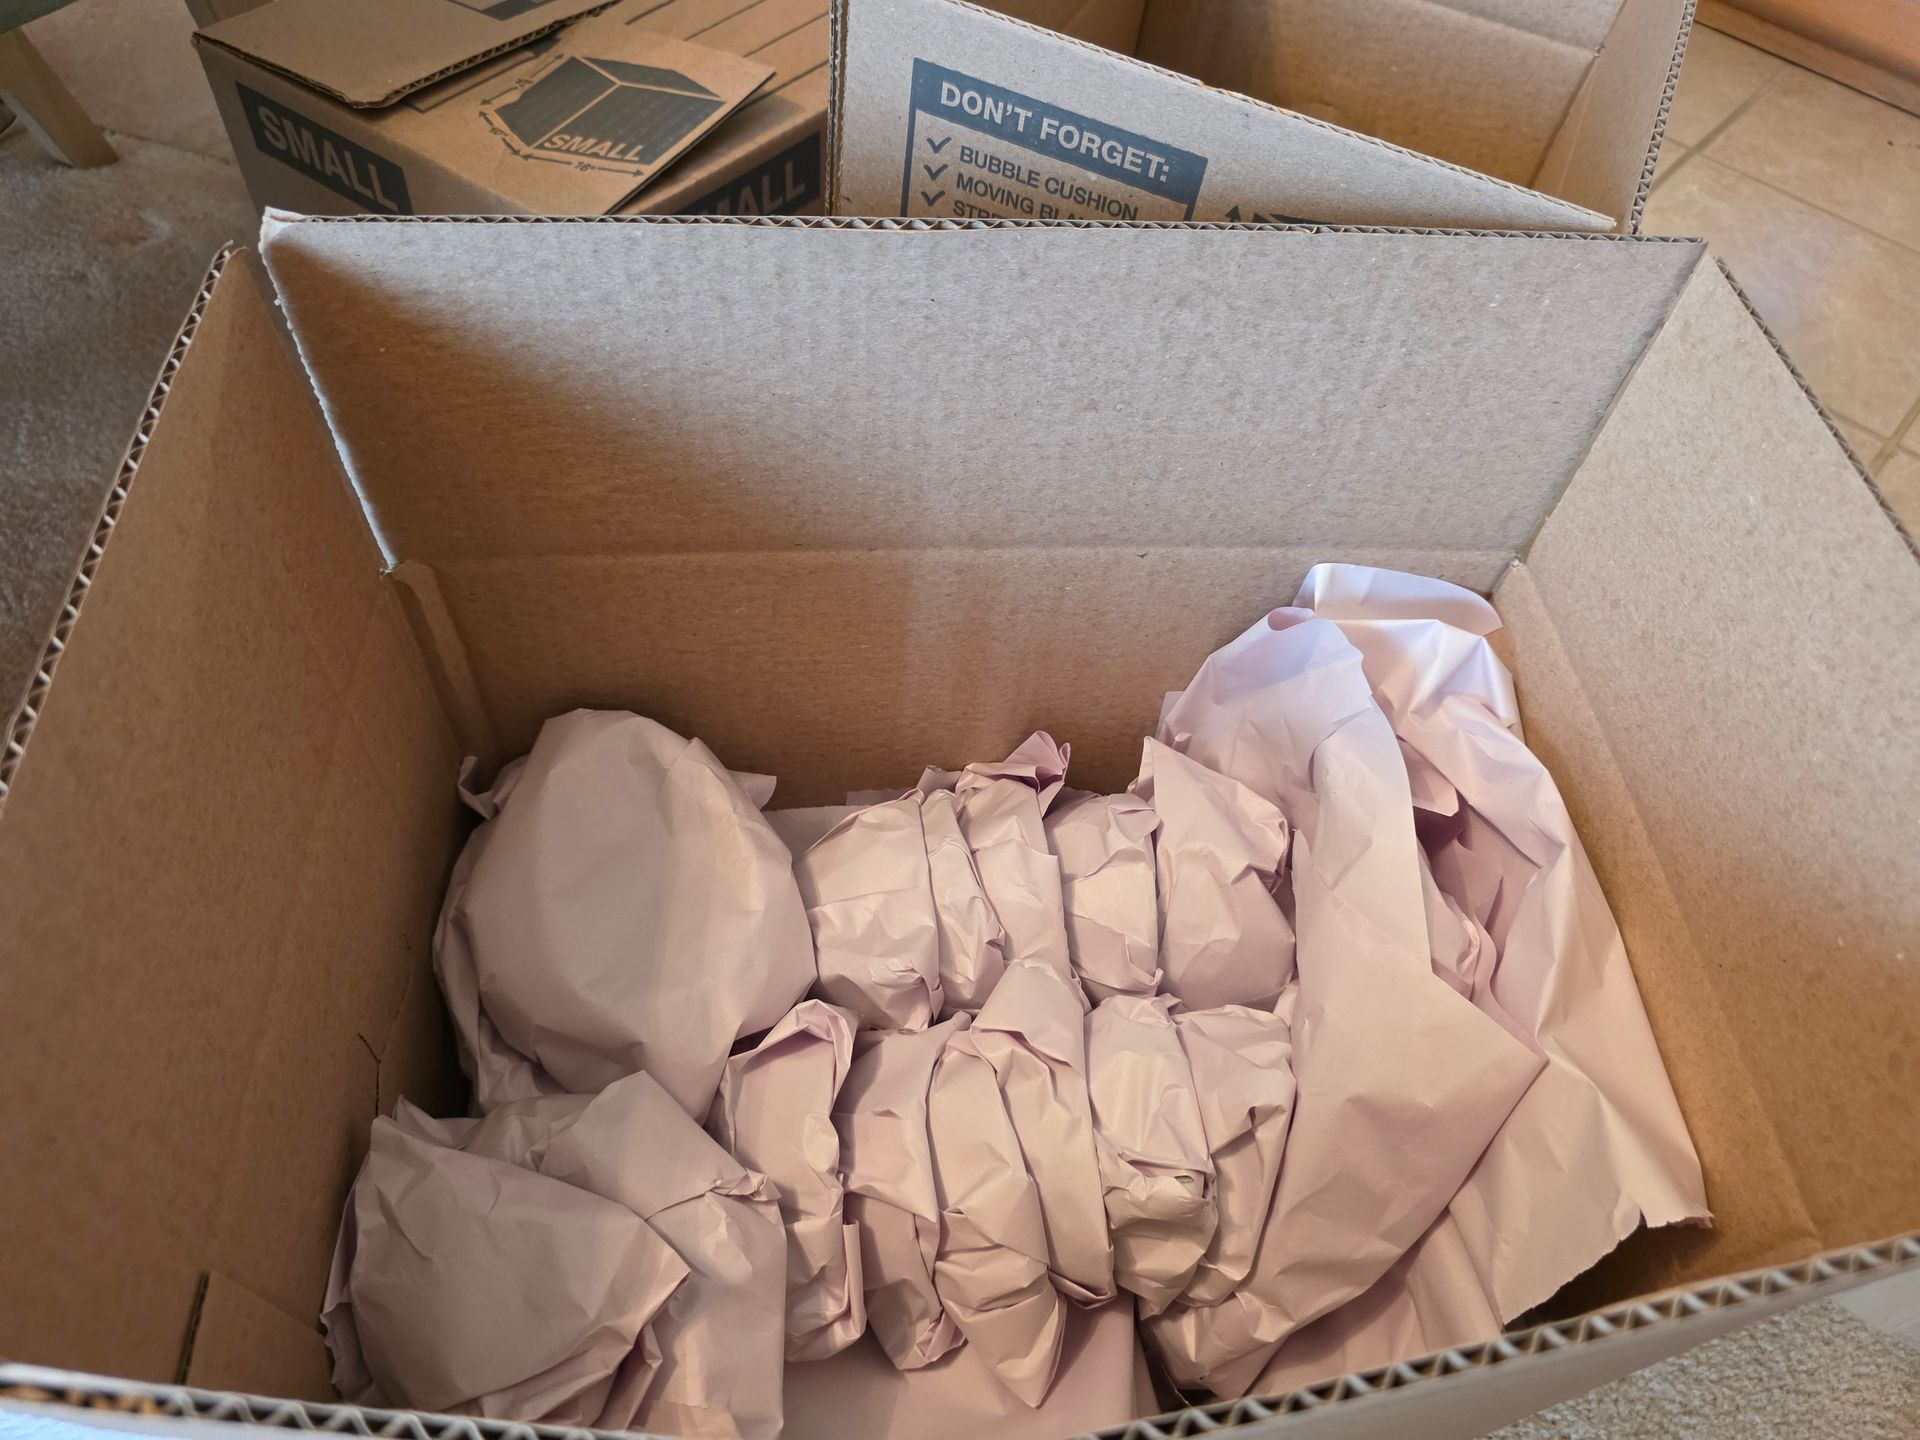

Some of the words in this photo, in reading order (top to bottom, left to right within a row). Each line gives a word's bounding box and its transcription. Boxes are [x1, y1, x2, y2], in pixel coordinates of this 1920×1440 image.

[258, 106, 399, 212] SMALL
[544, 134, 645, 162] SMALL
[940, 81, 1032, 132] DON'T
[1040, 117, 1170, 182] FORGET:
[956, 172, 1035, 216] MOVING
[960, 145, 1041, 188] BUBBLE
[1044, 177, 1139, 220] CUSHION
